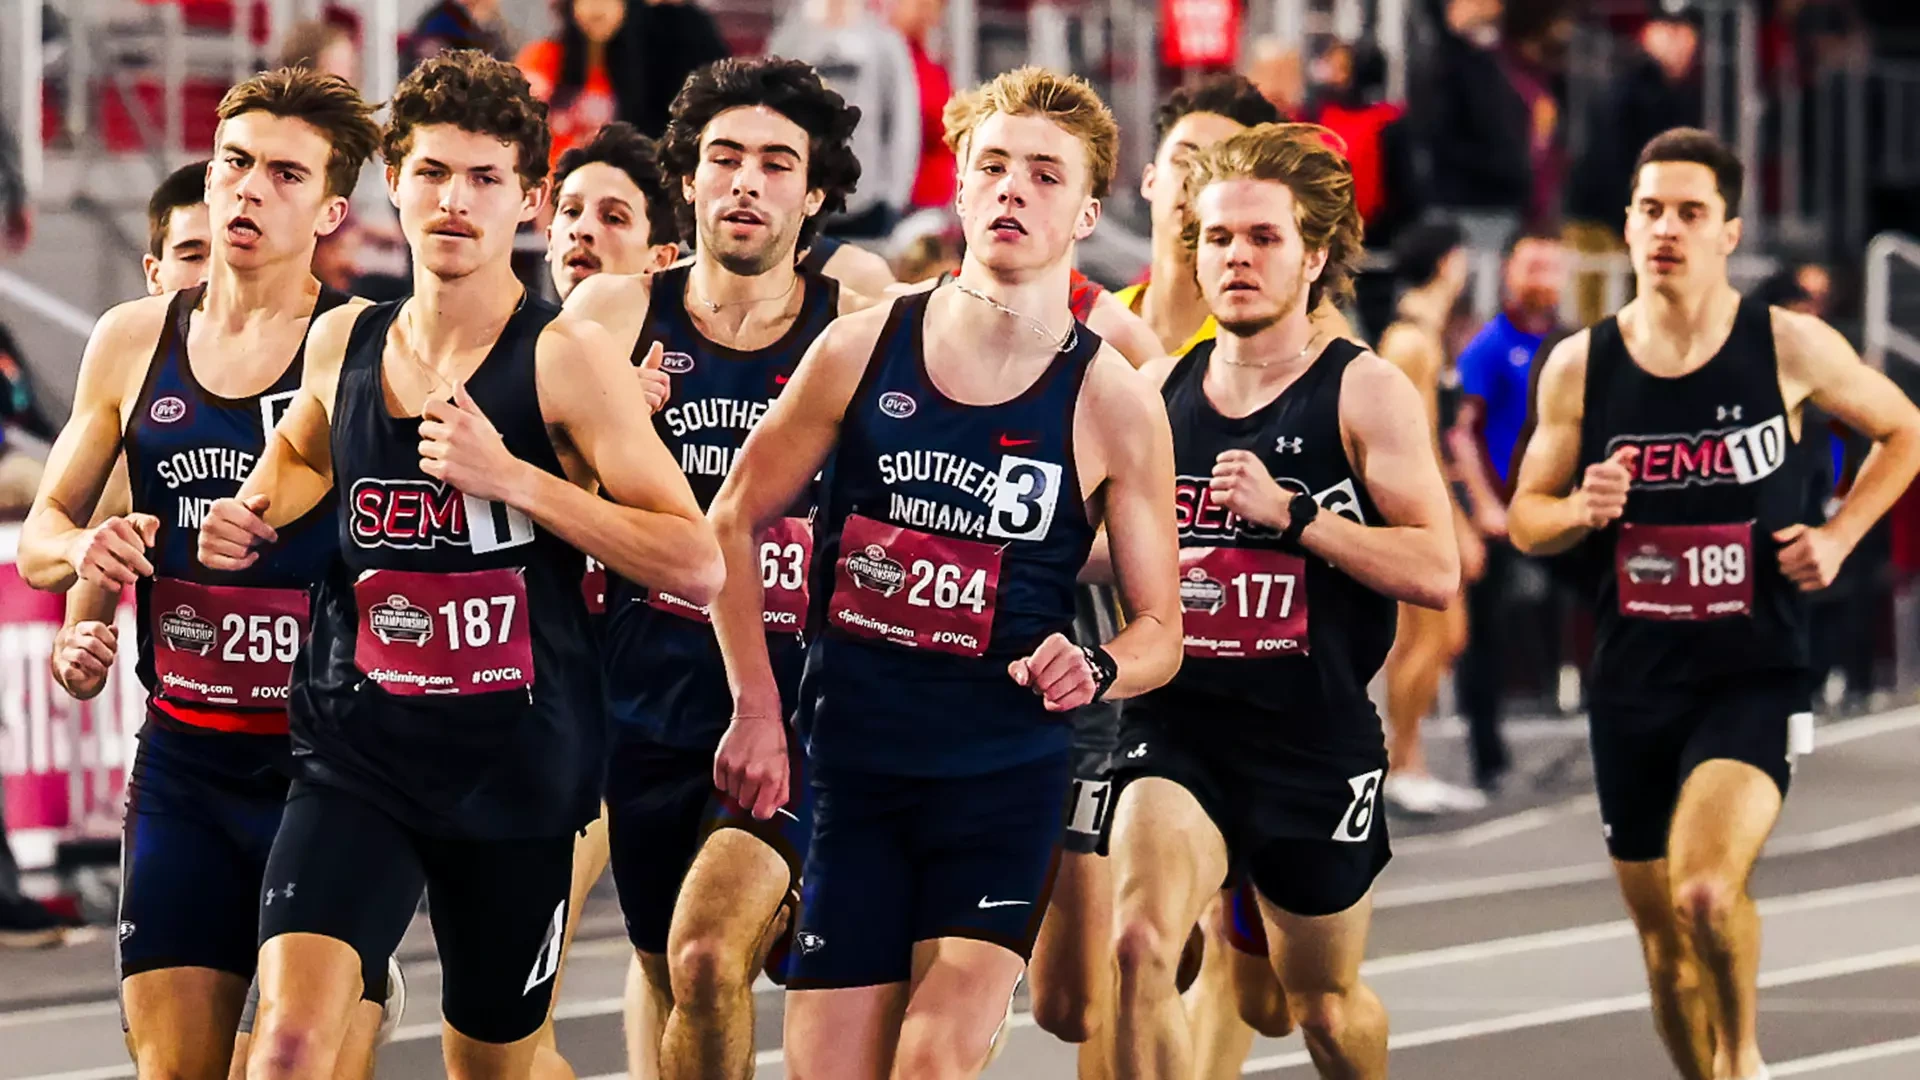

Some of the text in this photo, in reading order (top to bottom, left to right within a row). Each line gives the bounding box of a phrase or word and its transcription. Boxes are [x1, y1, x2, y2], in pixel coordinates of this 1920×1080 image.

[664, 398, 778, 437] SOUTHE
[1734, 425, 1778, 477] 10
[888, 492, 986, 539] INDIANA
[997, 463, 1047, 535] 3
[907, 559, 987, 614] 264
[1682, 543, 1746, 587] 189
[1231, 572, 1296, 618] 177
[163, 622, 213, 640] CHAMPIONSHIP
[222, 613, 300, 663] 259
[375, 614, 429, 629] CHAMPIONSHIP
[438, 595, 516, 650] 187
[838, 609, 915, 638] cfpitiming.com
[931, 631, 978, 649] #OVCit
[162, 672, 233, 695] cfpitiming.com
[367, 667, 522, 687] cfpitiming.com #OVCit
[1346, 776, 1377, 838] 6
